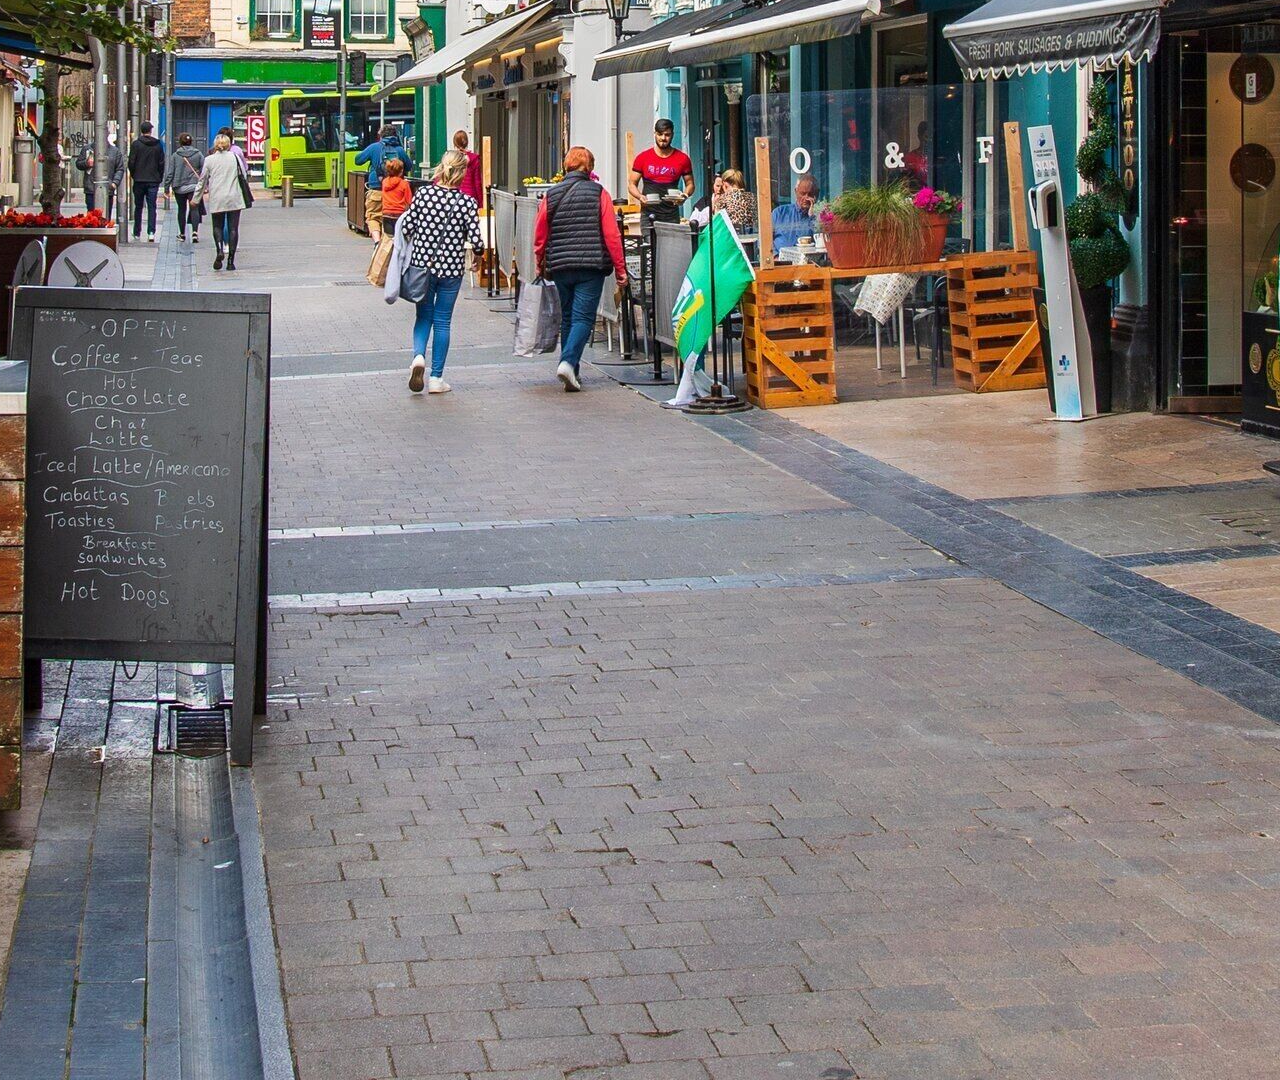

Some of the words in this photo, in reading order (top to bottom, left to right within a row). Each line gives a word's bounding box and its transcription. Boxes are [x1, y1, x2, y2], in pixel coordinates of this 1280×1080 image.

[968, 41, 991, 60] FRESH
[994, 38, 1015, 57] PORK
[1017, 34, 1062, 54] SAUSAGES
[1064, 35, 1073, 50] &
[1076, 26, 1127, 49] PUDDINGS
[789, 147, 811, 174] O
[885, 142, 905, 169] &
[976, 136, 994, 164] F
[101, 319, 177, 339] OPEN
[52, 344, 120, 366] Coffee
[155, 346, 204, 367] Teas
[103, 374, 137, 391] Hot
[66, 390, 190, 409] Chocolate
[95, 415, 146, 430] Chai
[90, 431, 153, 448] Latte
[34, 453, 77, 474] Iced
[45, 511, 115, 530] Toasties
[82, 535, 157, 551] Breakfast
[60, 580, 100, 602] Hot
[121, 582, 169, 610] Dogs
